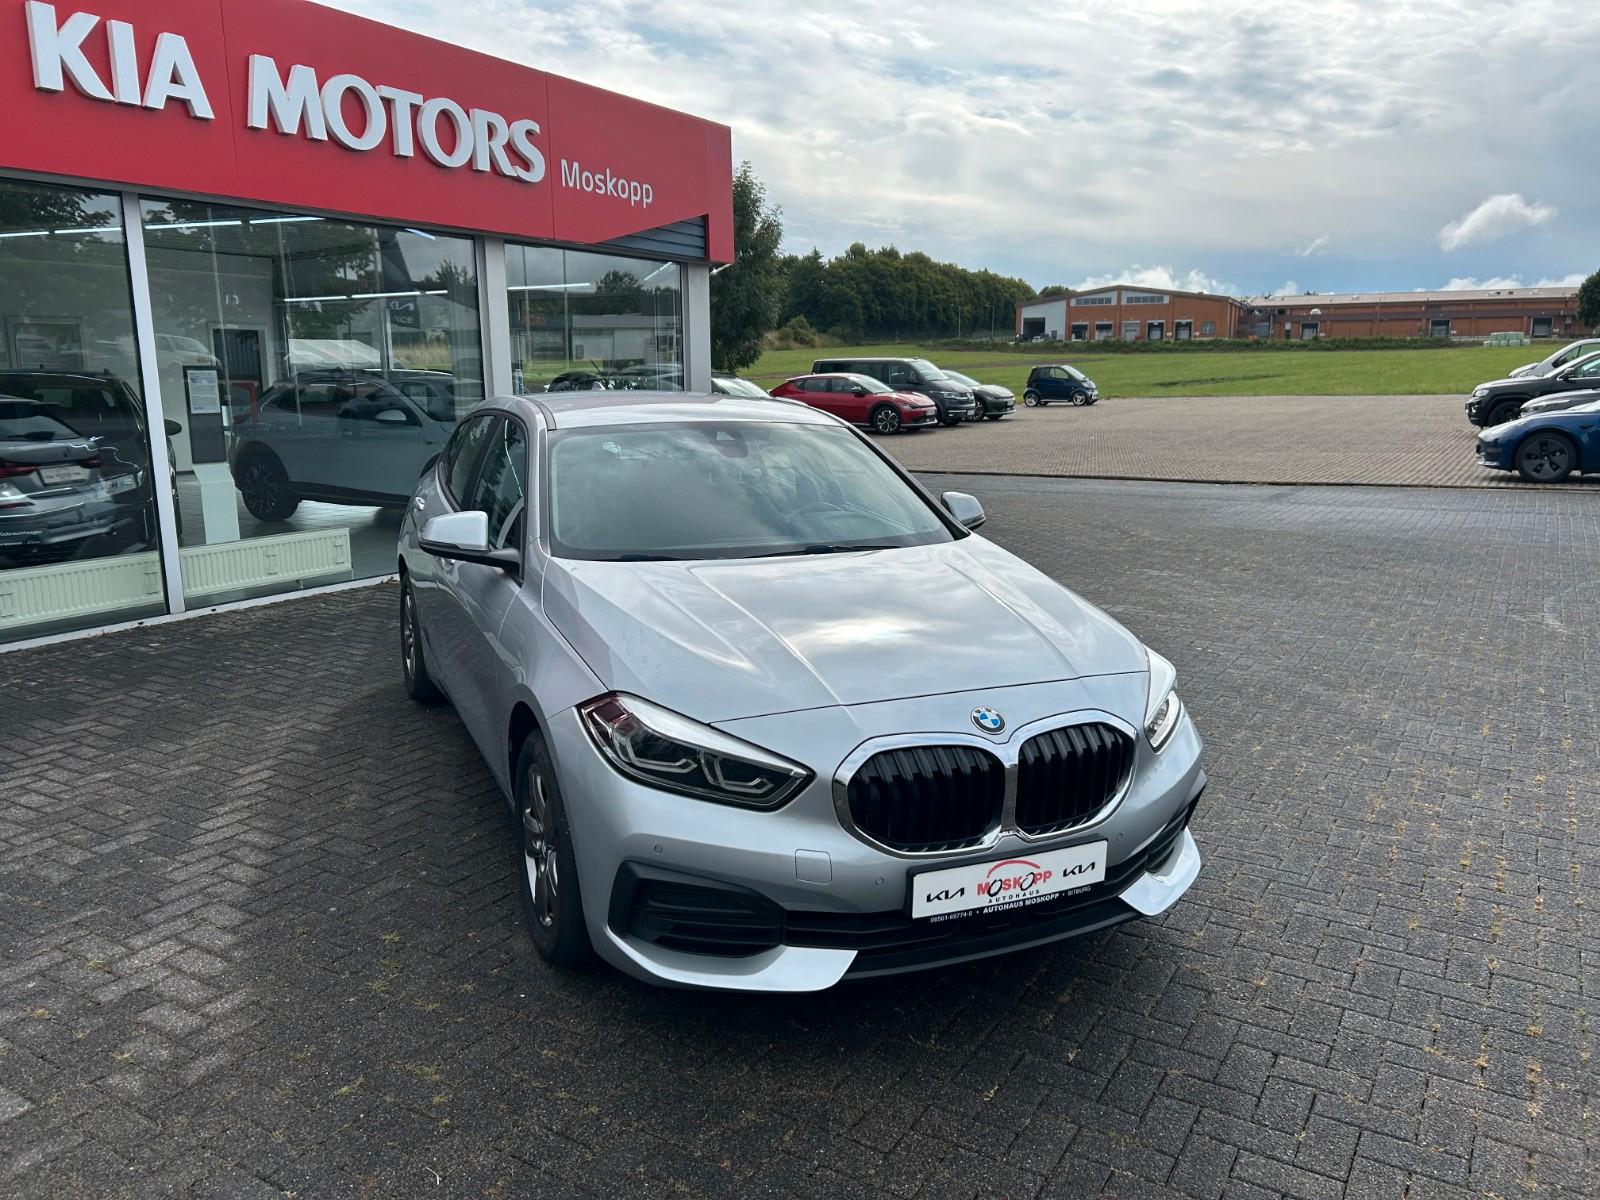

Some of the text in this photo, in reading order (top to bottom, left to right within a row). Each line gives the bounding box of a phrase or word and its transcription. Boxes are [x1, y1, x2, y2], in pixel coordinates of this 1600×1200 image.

[25, 0, 546, 183] KIA MOTORS
[560, 158, 653, 209] Moskopp
[977, 871, 1053, 897] MOSKOPP
[988, 889, 1040, 904] AUTOHAUS
[983, 901, 1024, 914] AUTOHAUS
[1024, 893, 1060, 906] MOSKOPP
[1067, 885, 1092, 896] BITBURG
